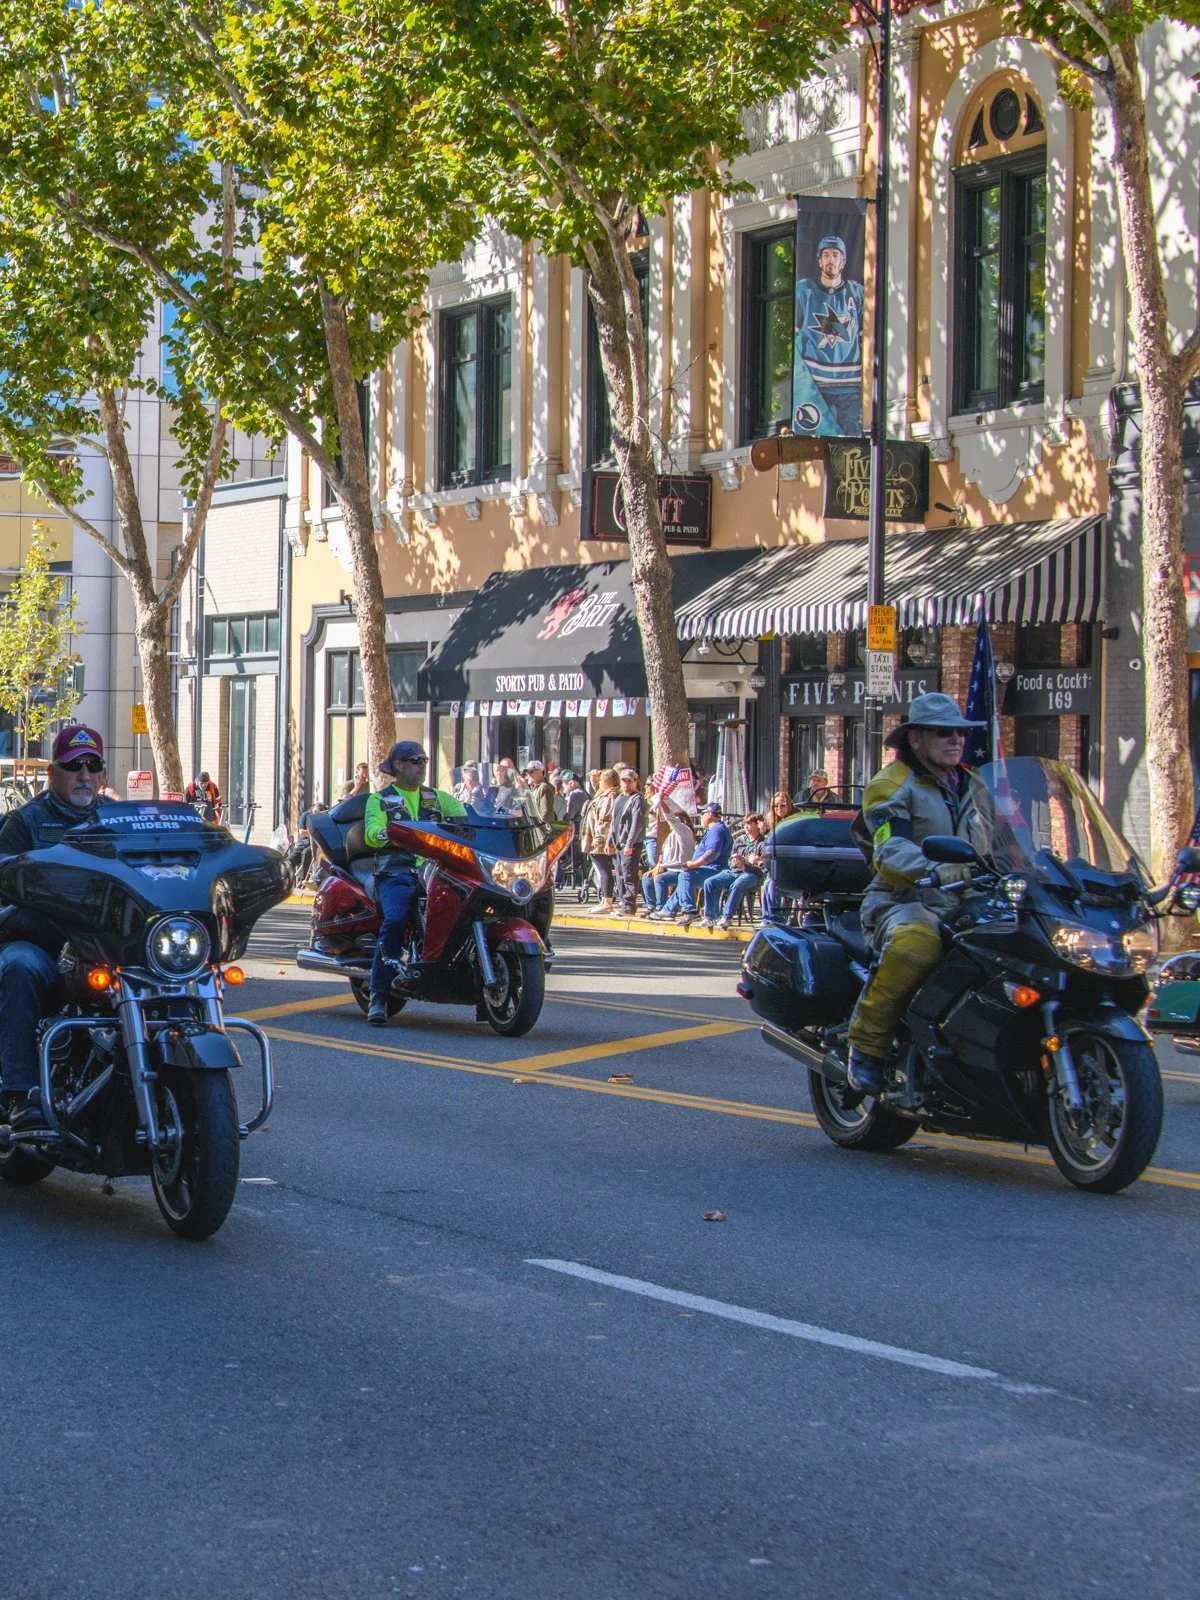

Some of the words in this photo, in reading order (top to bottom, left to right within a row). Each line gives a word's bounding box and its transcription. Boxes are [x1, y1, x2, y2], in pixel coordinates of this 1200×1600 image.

[843, 447, 870, 481] FIV
[846, 478, 905, 513] POTS
[664, 525, 675, 533] PUB
[683, 526, 699, 534] PATIO
[597, 592, 618, 604] THE
[871, 607, 892, 617] FREIGHT
[870, 617, 893, 626] LOADING
[875, 626, 888, 635] ZONE
[873, 654, 890, 663] TAXI
[870, 664, 892, 673] STAND
[496, 675, 525, 692] SPORTS
[528, 674, 544, 692] PUB
[548, 674, 557, 691] &
[559, 673, 584, 691] PATIO
[1016, 674, 1043, 691] Food
[1046, 677, 1053, 689] &
[789, 682, 835, 705] FIVE
[853, 680, 927, 704] PNTS
[1048, 691, 1072, 710] 169
[128, 780, 138, 789] NO
[102, 815, 155, 826] PATRIOT
[160, 815, 203, 824] GUARD
[132, 821, 180, 830] RIDERS
